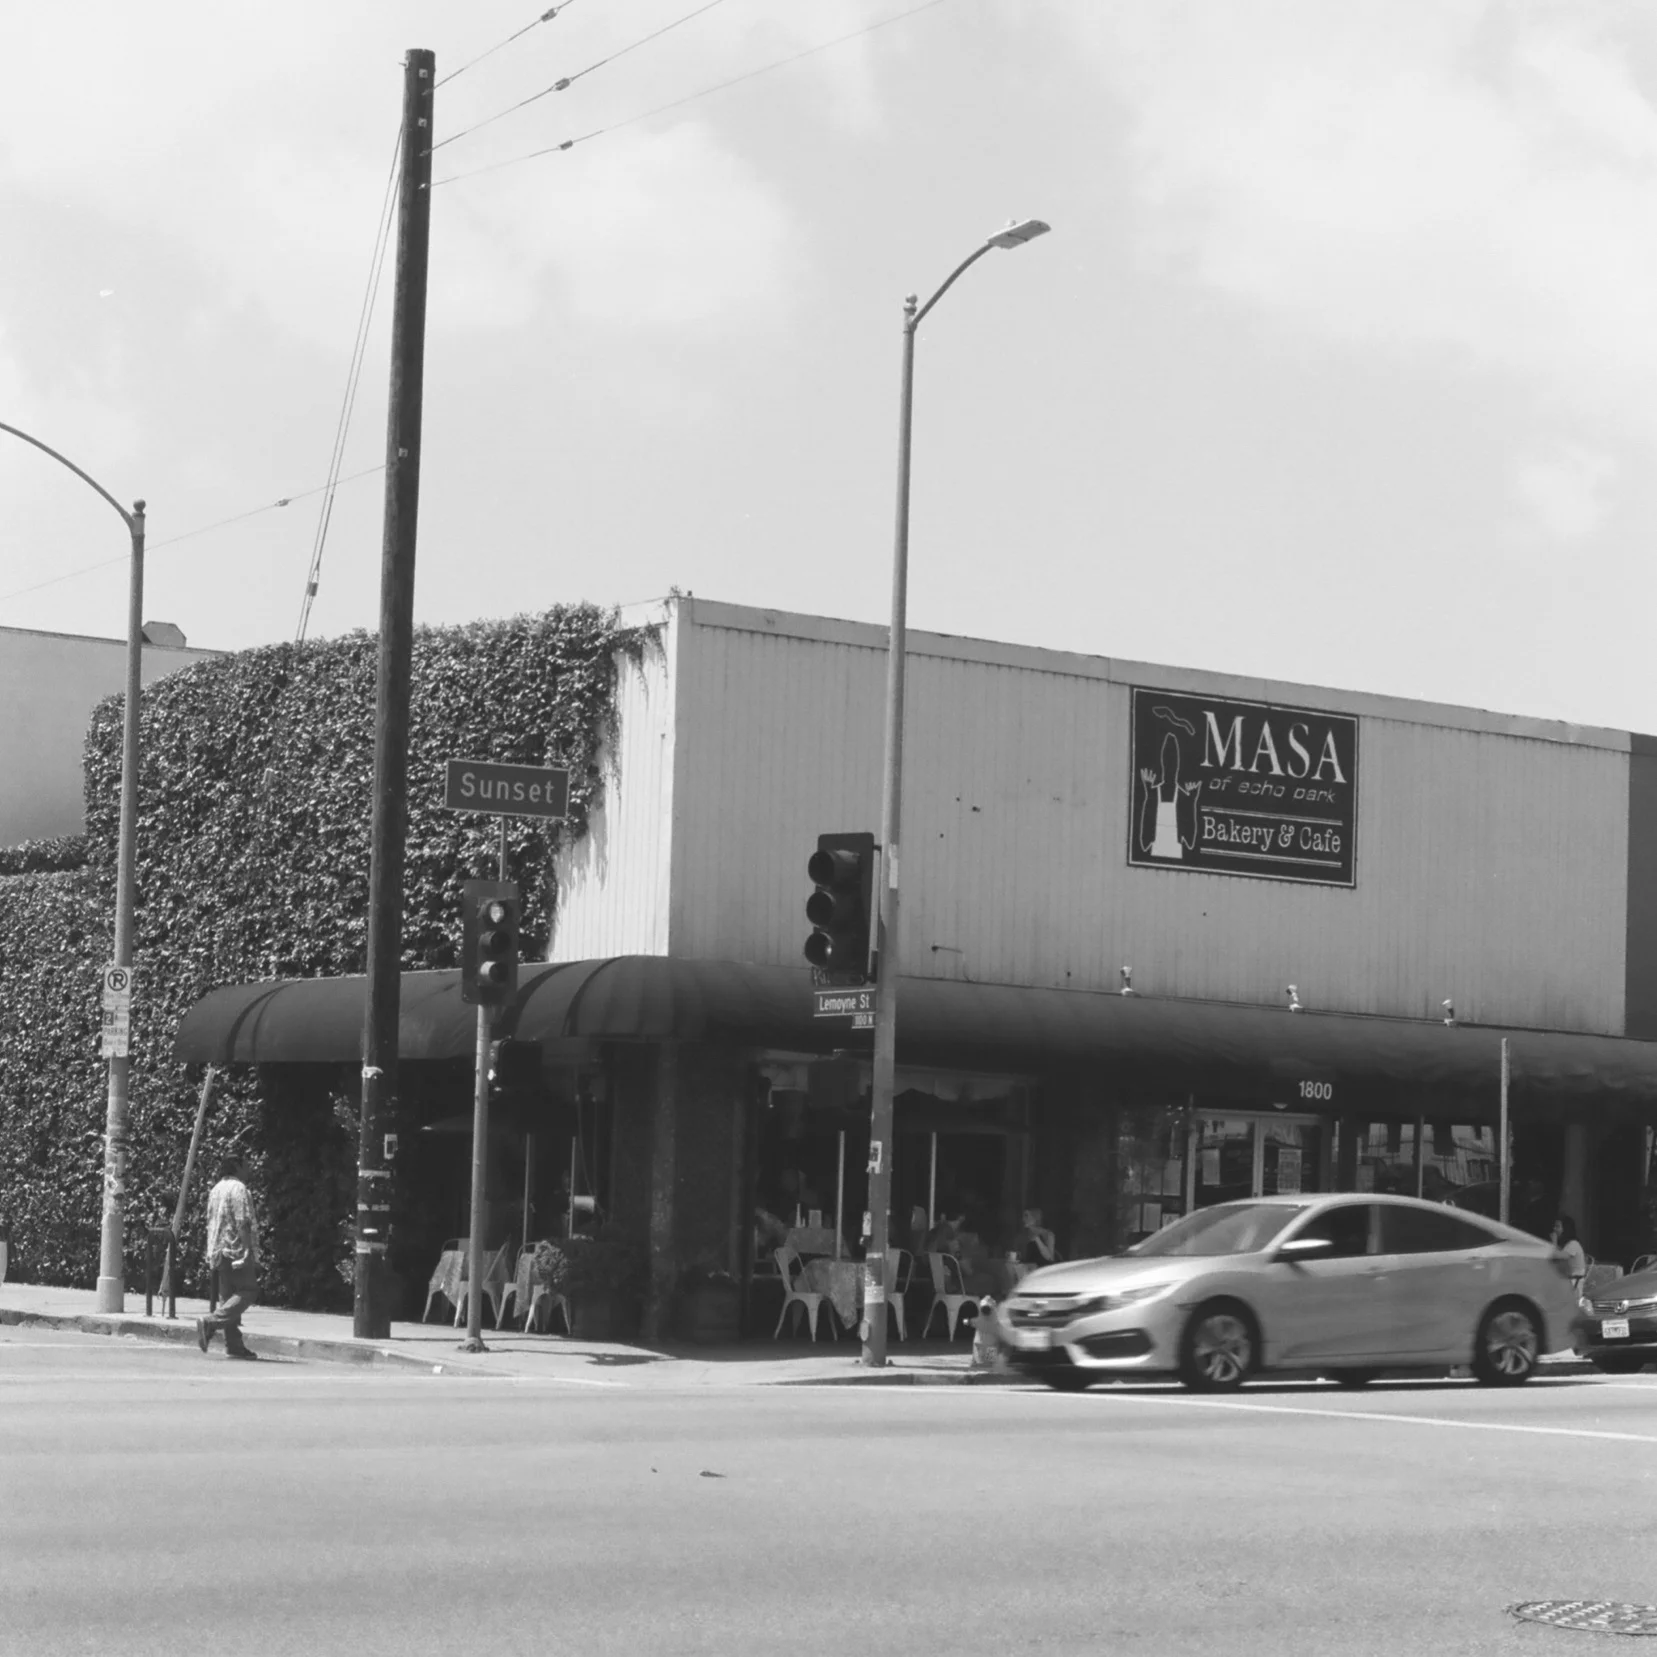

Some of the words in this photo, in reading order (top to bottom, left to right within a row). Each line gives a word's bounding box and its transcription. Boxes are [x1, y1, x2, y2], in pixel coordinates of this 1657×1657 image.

[1200, 711, 1347, 784] MASA
[460, 772, 555, 804] Sunset
[1209, 776, 1232, 791] of
[1238, 780, 1286, 798] echo
[1293, 786, 1337, 804] park
[1202, 815, 1275, 852] Bakery
[1278, 824, 1295, 848] &
[1299, 826, 1341, 853] Cafe
[819, 996, 856, 1014] Lemoyne
[860, 993, 870, 1008] St
[1299, 1080, 1332, 1100] 1800
